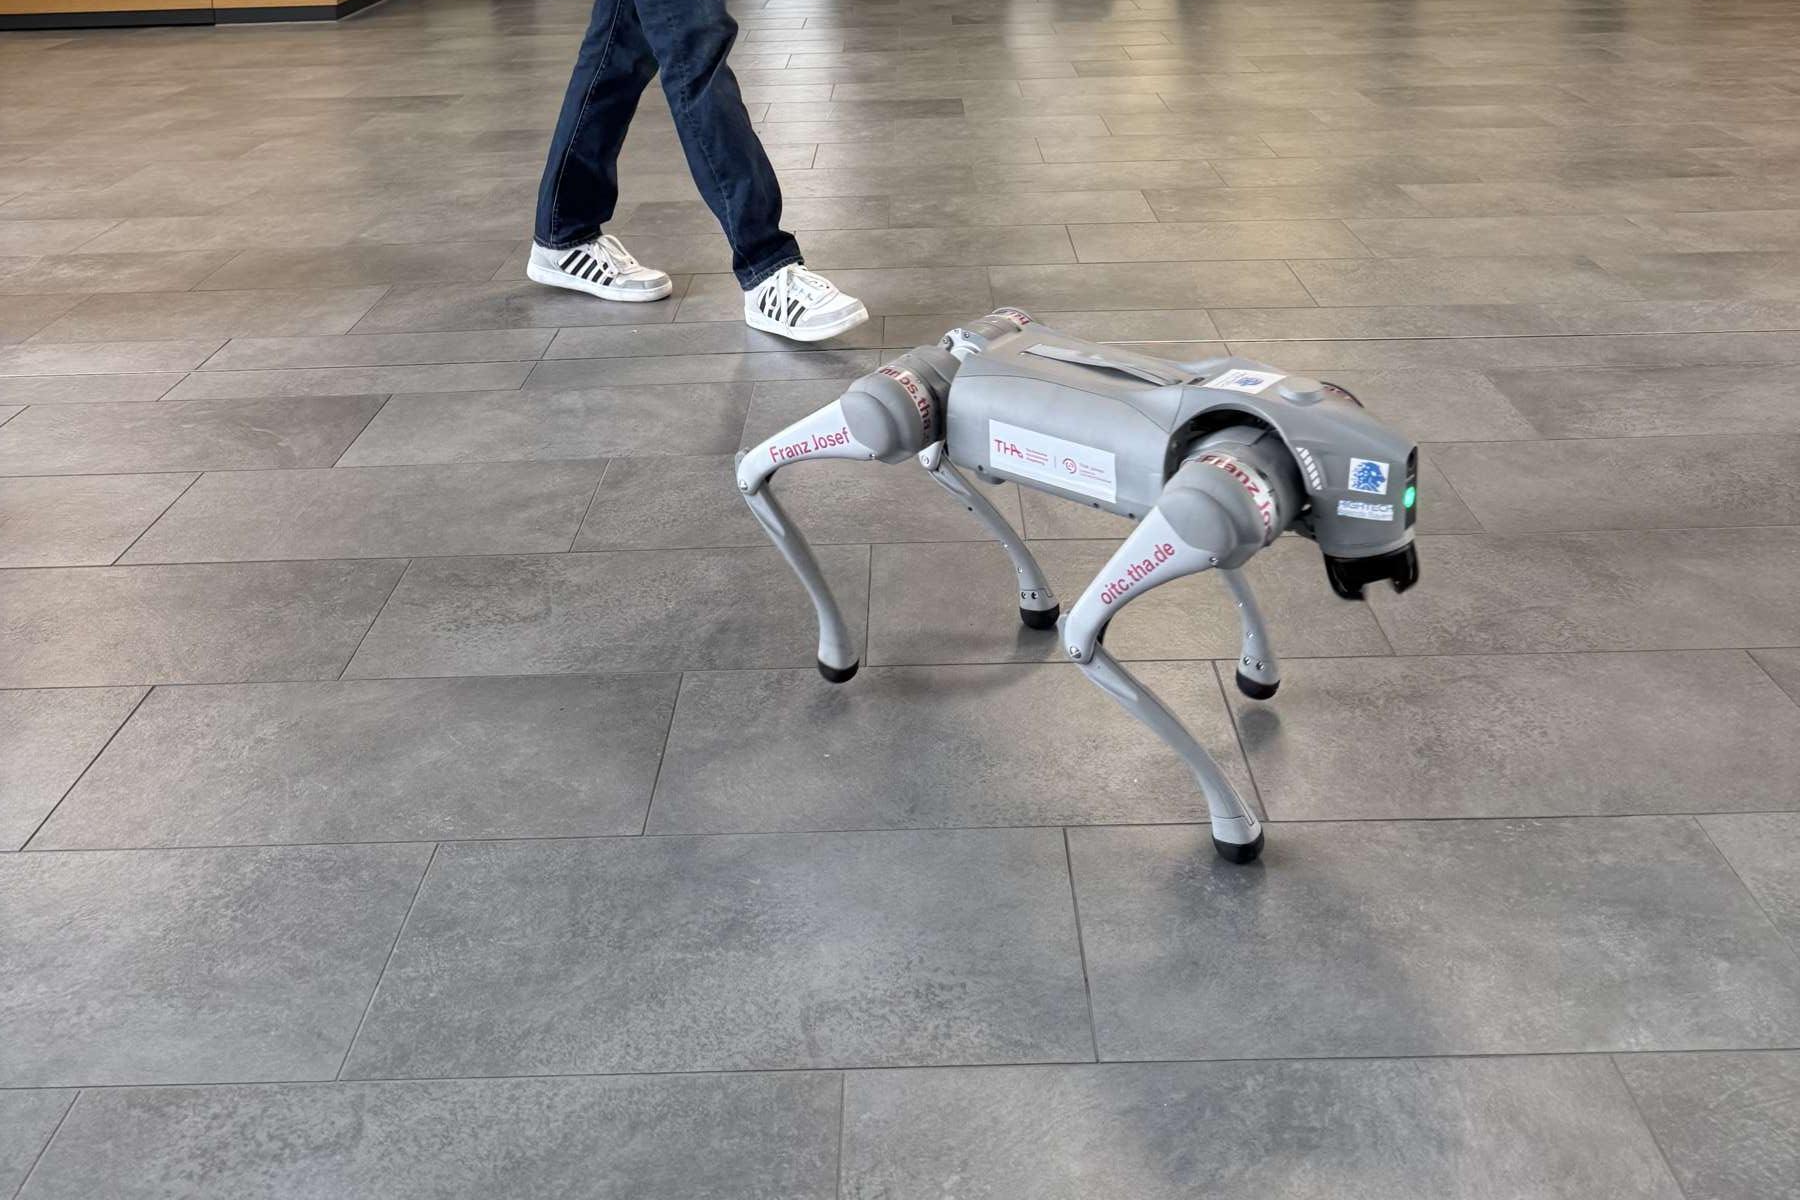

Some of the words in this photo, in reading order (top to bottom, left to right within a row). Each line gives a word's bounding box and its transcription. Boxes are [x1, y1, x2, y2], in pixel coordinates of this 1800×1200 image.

[768, 441, 812, 463] Franz
[811, 426, 850, 451] Josef
[1100, 543, 1176, 606] oitc.tha.de
